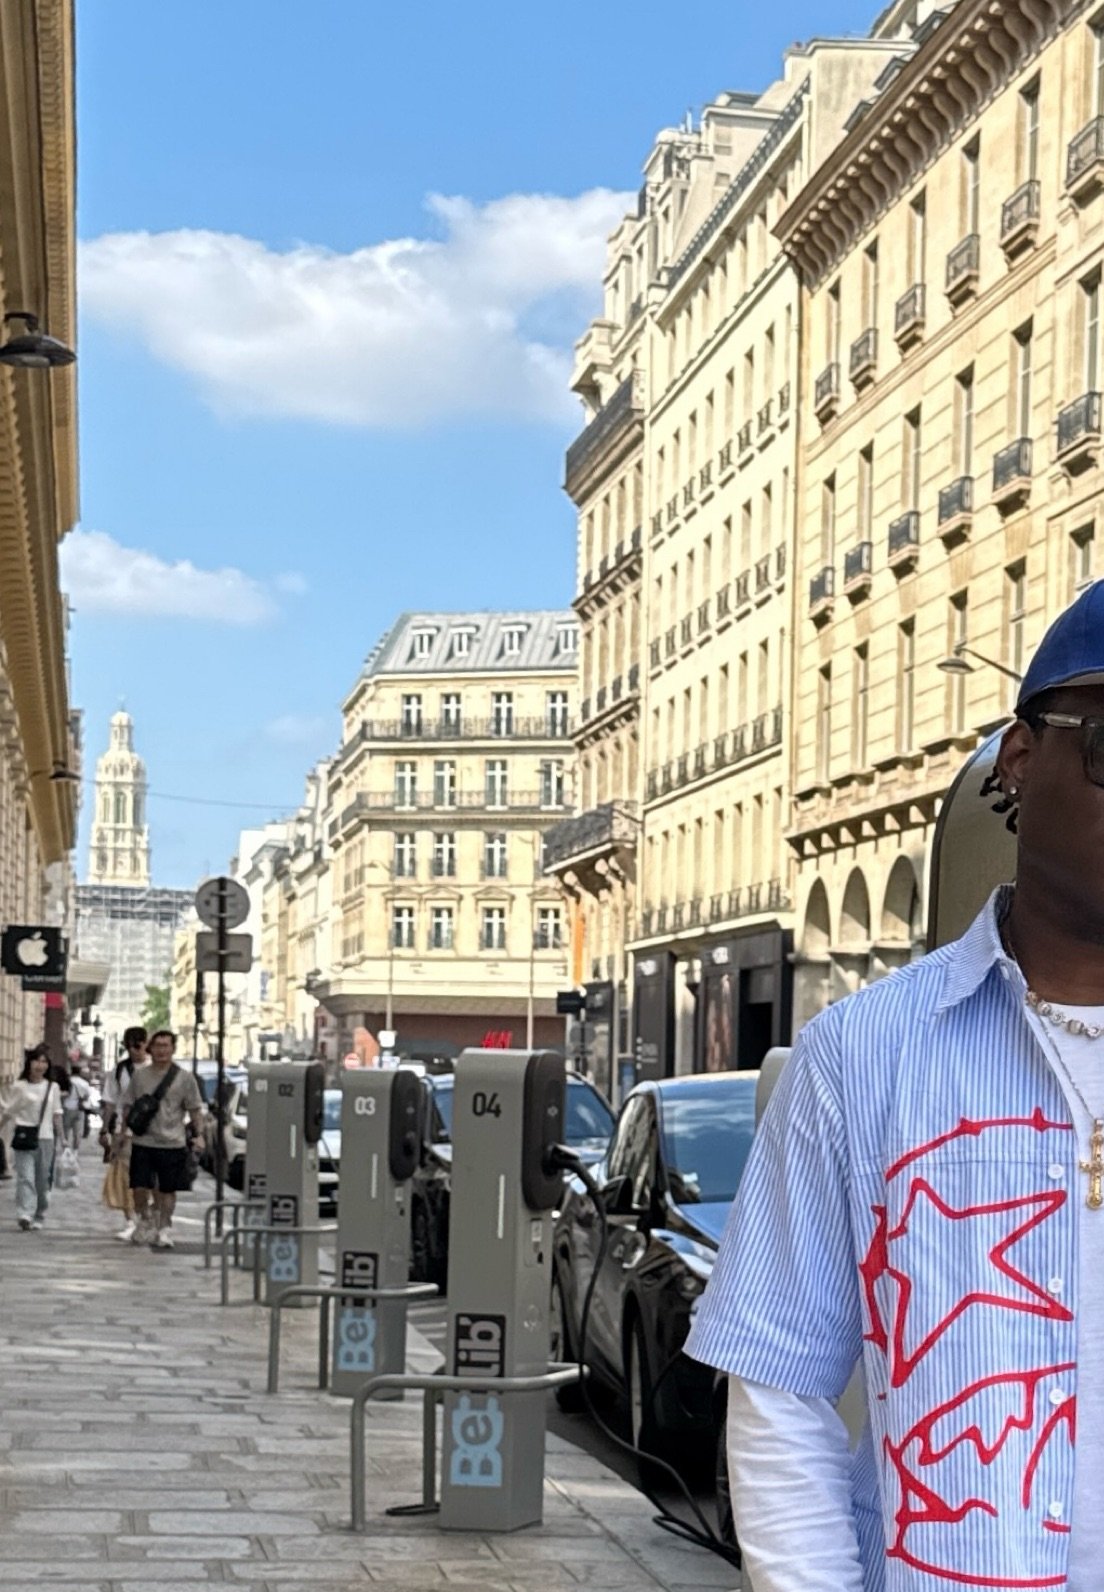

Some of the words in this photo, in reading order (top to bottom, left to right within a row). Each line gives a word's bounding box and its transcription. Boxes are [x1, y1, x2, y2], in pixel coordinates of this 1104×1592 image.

[278, 1083, 295, 1097] 02
[354, 1096, 376, 1116] 03
[472, 1091, 502, 1118] 04
